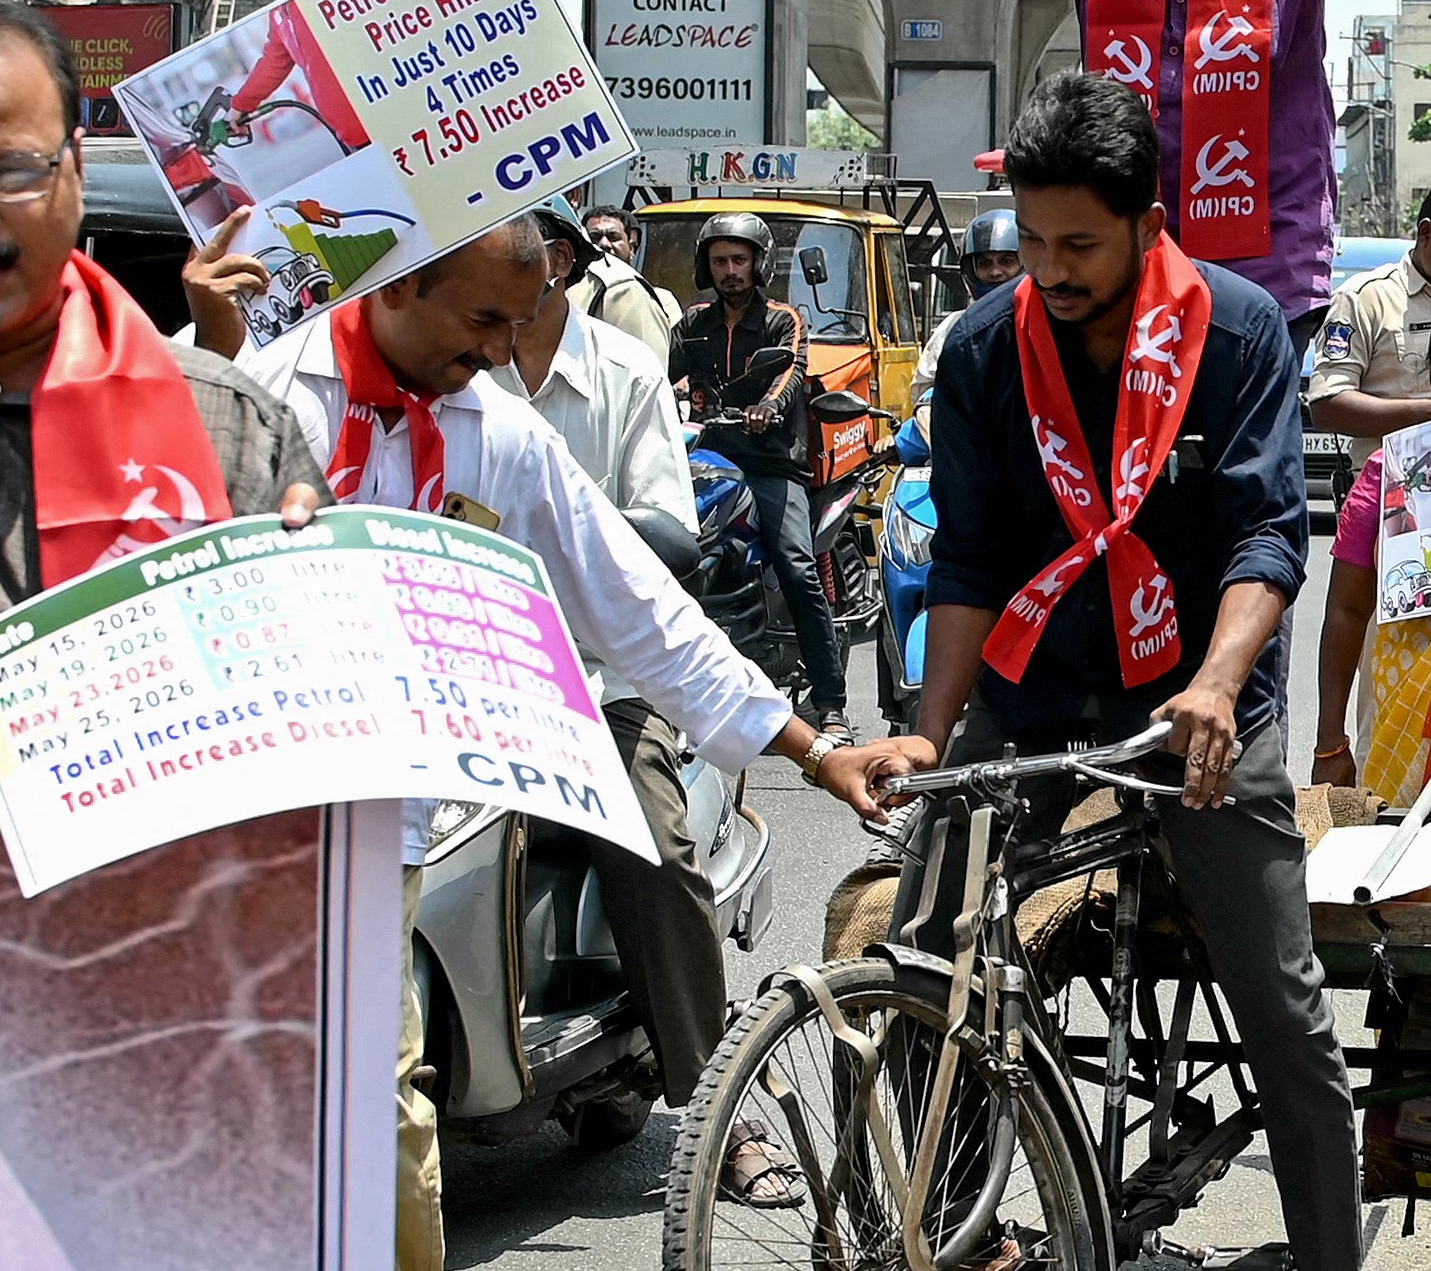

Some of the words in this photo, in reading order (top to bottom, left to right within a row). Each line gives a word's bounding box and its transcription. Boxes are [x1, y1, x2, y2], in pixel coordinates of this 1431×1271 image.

[87, 39, 133, 54] CLICK,
[364, 2, 433, 52] Price
[604, 23, 754, 48] LEADSPACE
[915, 23, 940, 39] 1084
[356, 73, 389, 104] In
[392, 44, 446, 91] Just
[444, 23, 476, 59] 10
[425, 84, 444, 114] 4
[440, 51, 522, 105] Times
[604, 77, 751, 100] 7396001111
[411, 108, 480, 165] 7.50
[480, 64, 587, 134] Increase
[494, 111, 612, 192] CPM
[833, 420, 867, 449] Swiggy
[49, 738, 124, 785] Total
[135, 699, 263, 752] Increase
[274, 682, 365, 712] Petrol
[395, 676, 468, 708] 7.50
[60, 764, 138, 814] Total
[142, 729, 279, 788] Increase
[287, 713, 381, 743] Diesel
[411, 709, 482, 742] 7.60
[457, 751, 607, 820] CPM
